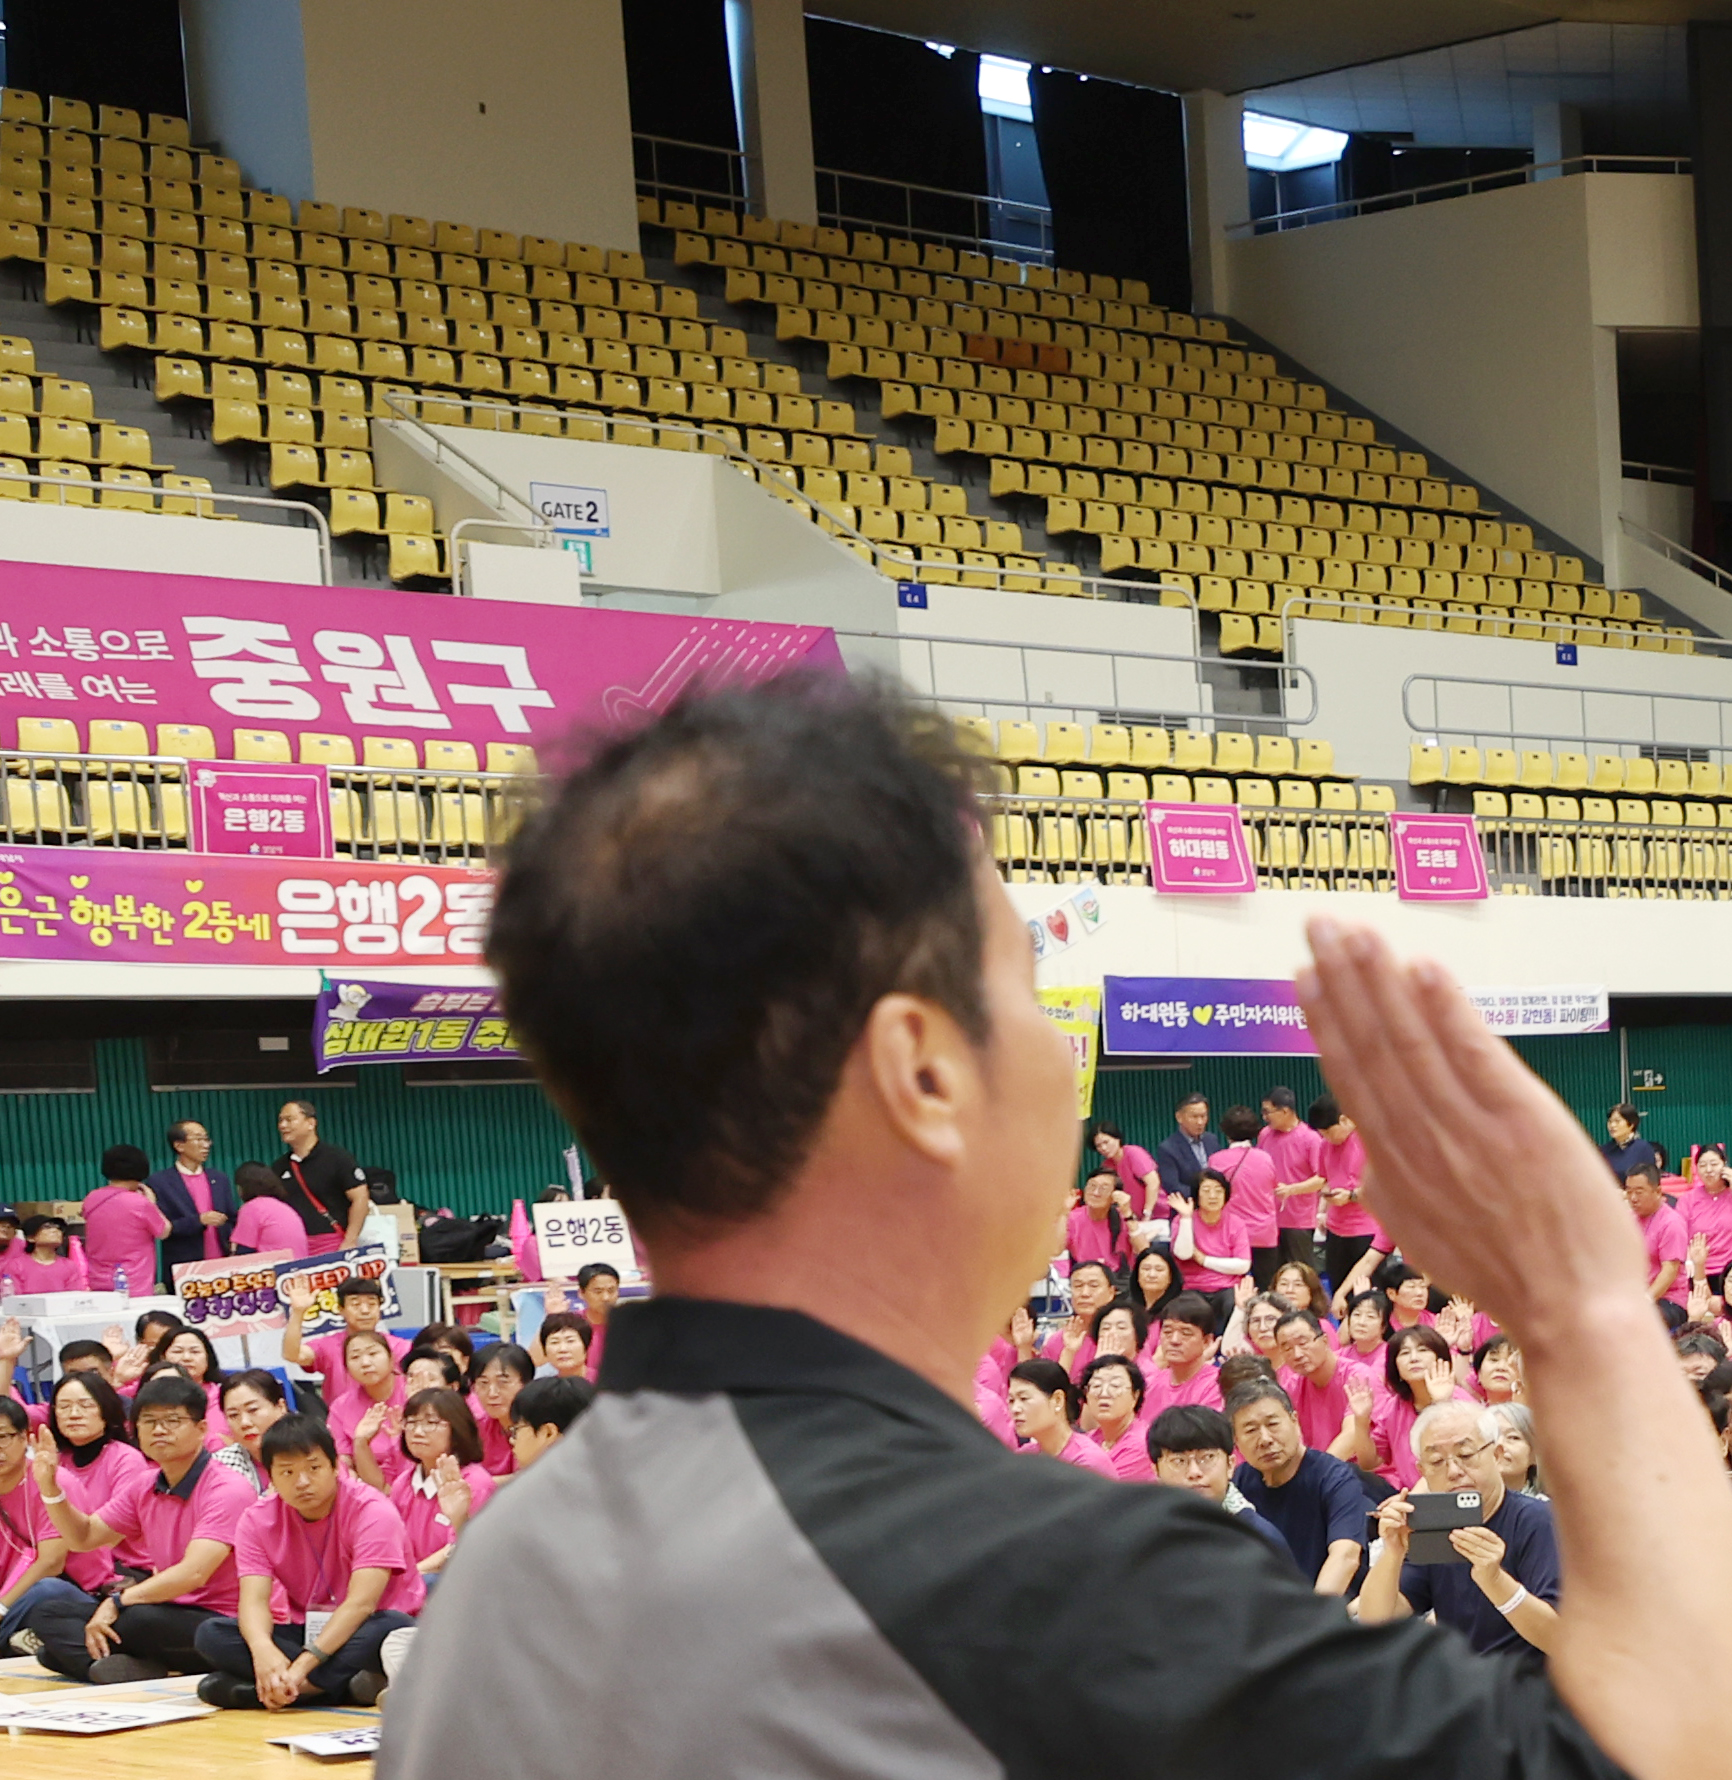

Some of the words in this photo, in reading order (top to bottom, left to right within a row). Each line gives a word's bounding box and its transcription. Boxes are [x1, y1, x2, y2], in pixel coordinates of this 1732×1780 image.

[28, 625, 175, 662] 소통으로
[0, 671, 79, 700] 래를
[80, 673, 159, 705] 여는
[181, 615, 555, 735] 중원구
[222, 807, 306, 833] 은행2동
[1168, 838, 1230, 860] 하대원동
[1416, 848, 1458, 869] 도촌동
[69, 882, 176, 948] 행복한
[181, 900, 272, 945] 2동네
[1119, 1001, 1191, 1029] 하대원동
[323, 1018, 471, 1058] 상대원1동
[472, 1018, 521, 1050] 주
[544, 1215, 626, 1248] 은행2동
